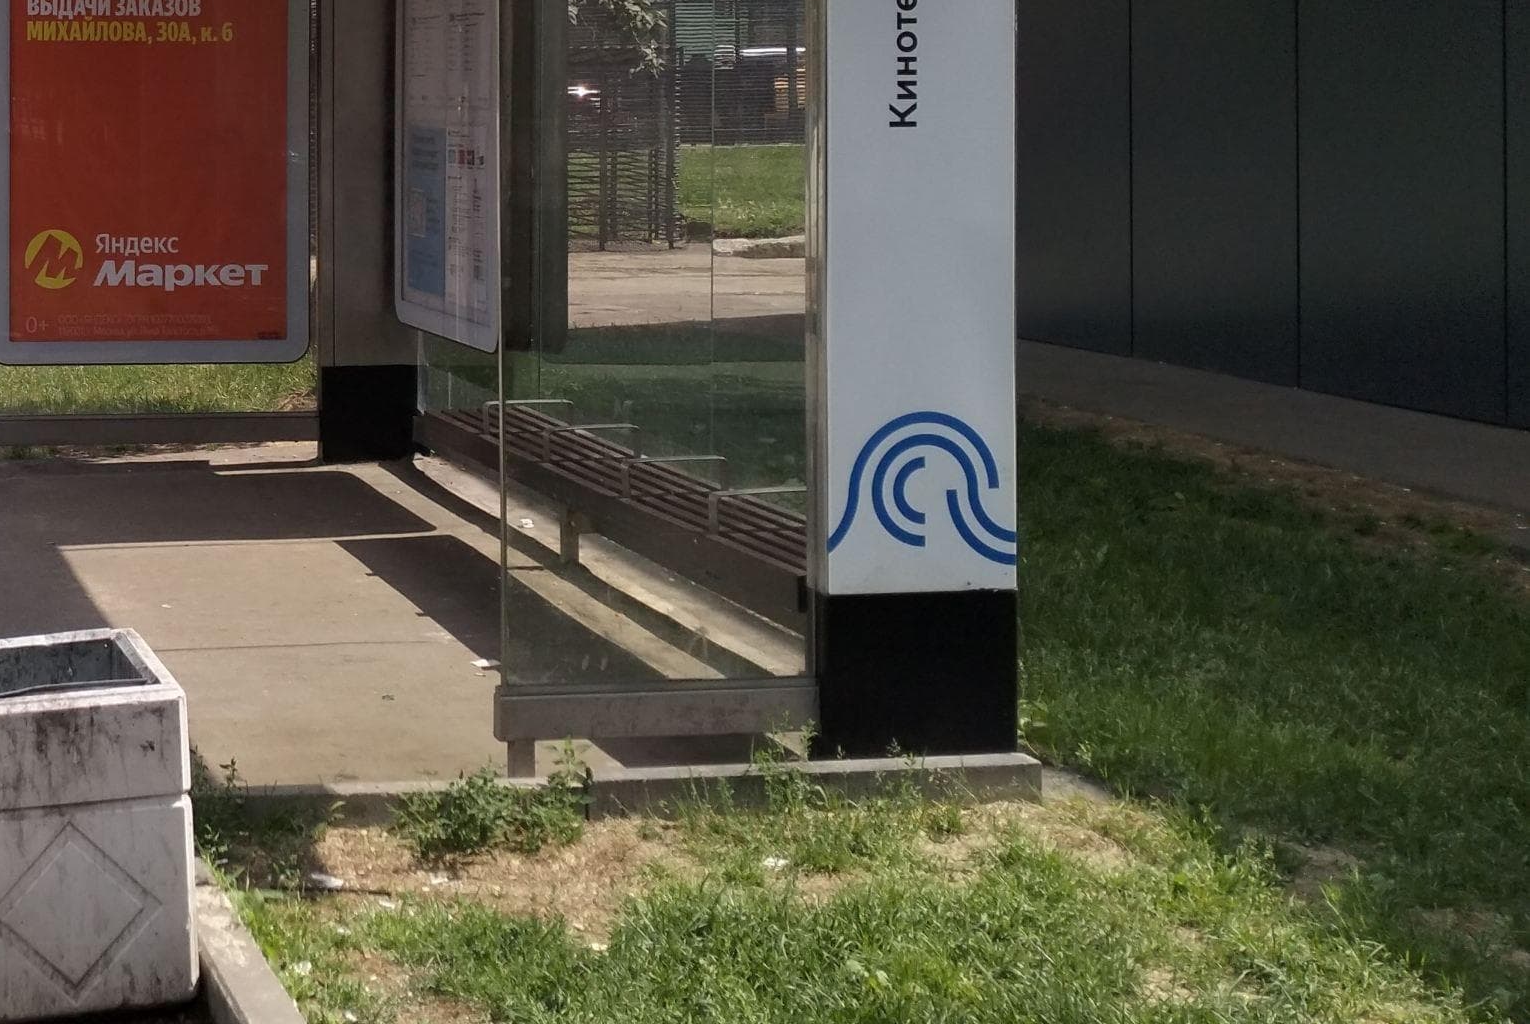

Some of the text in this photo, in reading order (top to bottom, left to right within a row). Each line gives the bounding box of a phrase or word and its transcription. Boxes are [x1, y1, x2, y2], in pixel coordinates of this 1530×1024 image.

[26, 16, 234, 44] МИХАЙЛОВА, 30А, к. 6
[94, 233, 180, 257] Яндекс
[92, 259, 269, 292] Маркет
[25, 315, 50, 334] 0+
